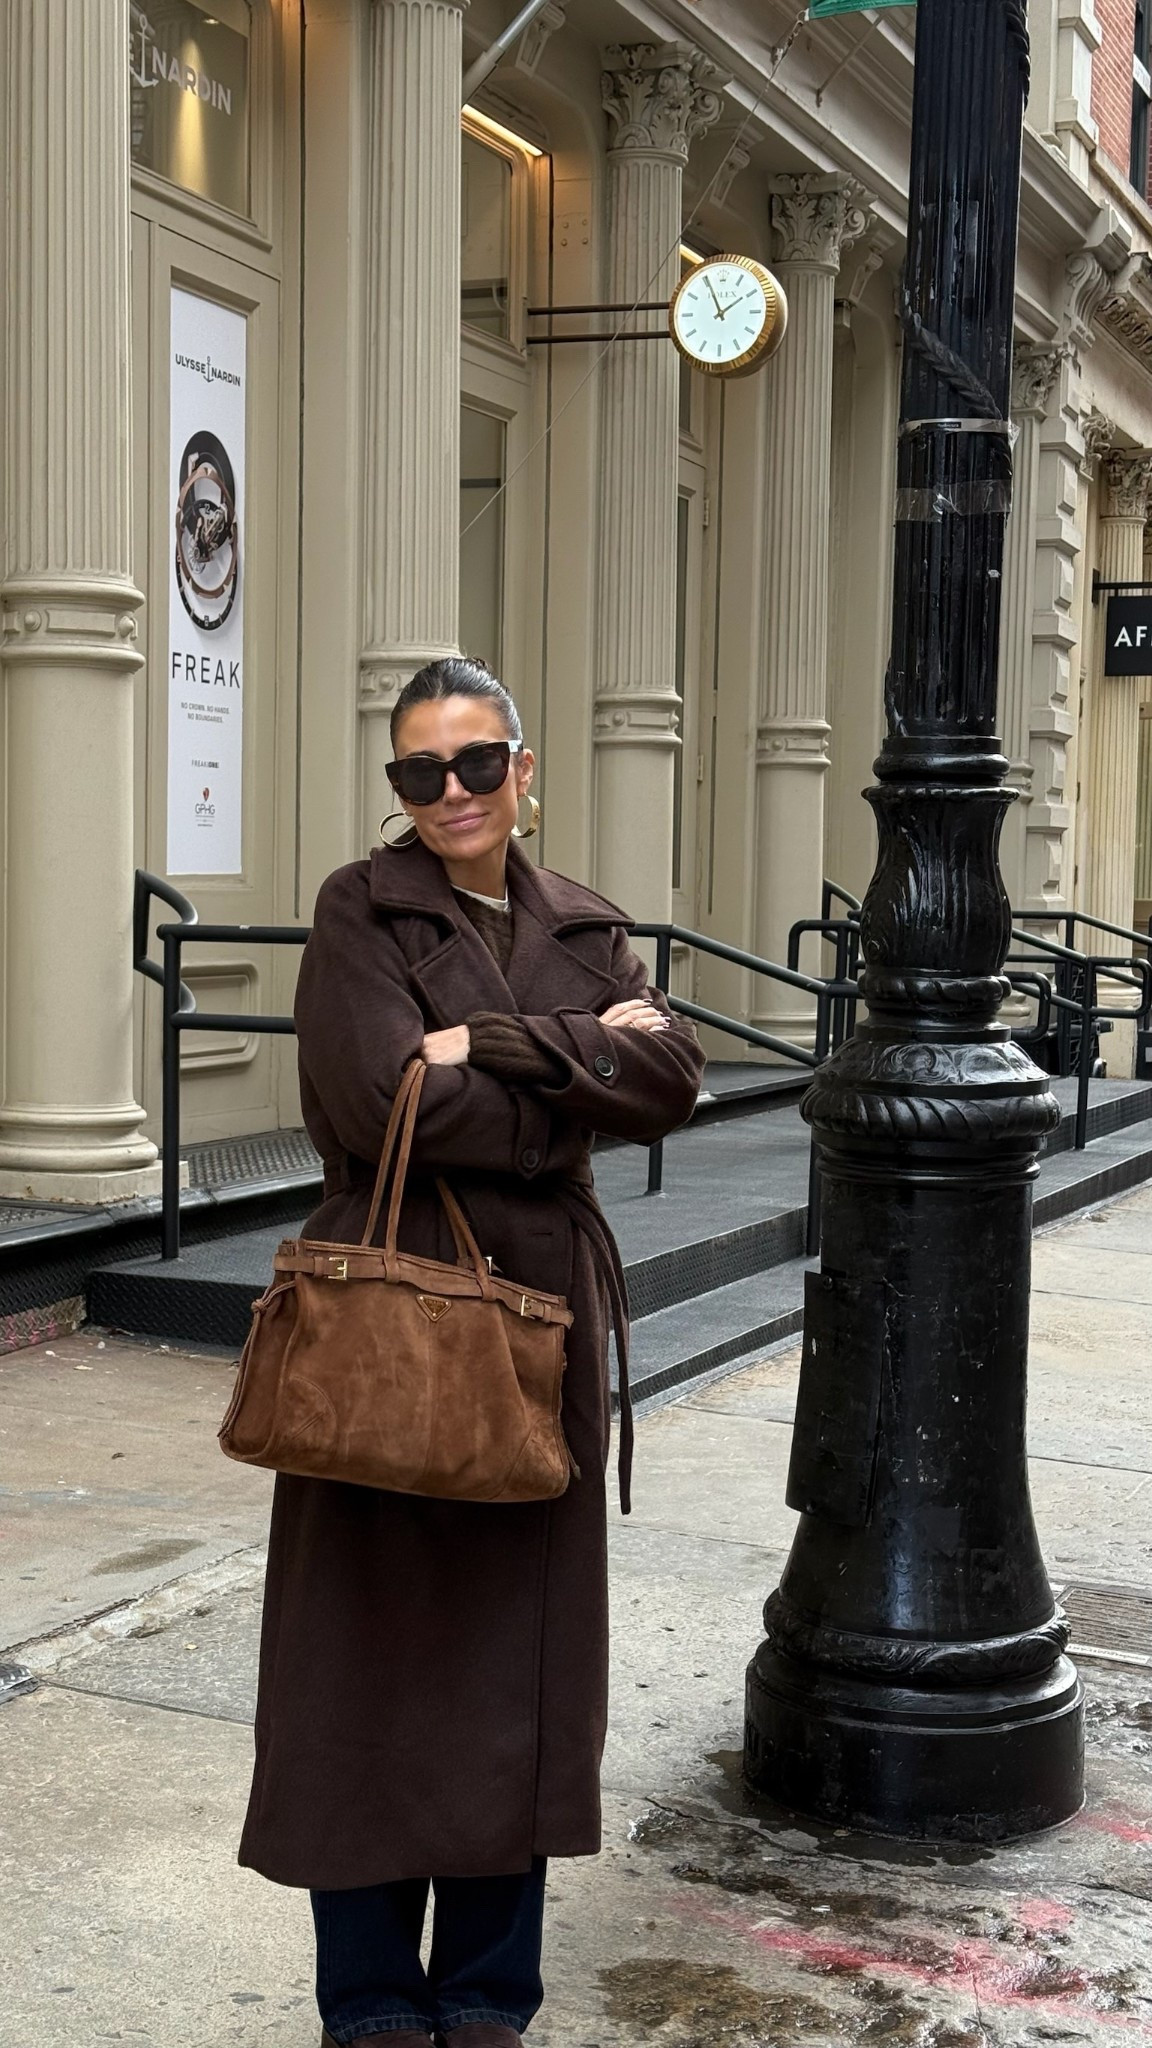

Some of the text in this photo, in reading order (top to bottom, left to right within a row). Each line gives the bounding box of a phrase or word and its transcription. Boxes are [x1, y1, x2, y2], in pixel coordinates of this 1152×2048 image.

[152, 46, 231, 116] NARDIN
[175, 353, 241, 387] ULYSSE NARDIN
[1113, 625, 1152, 647] AF
[172, 651, 240, 689] FREAK
[195, 803, 216, 815] GPHG
